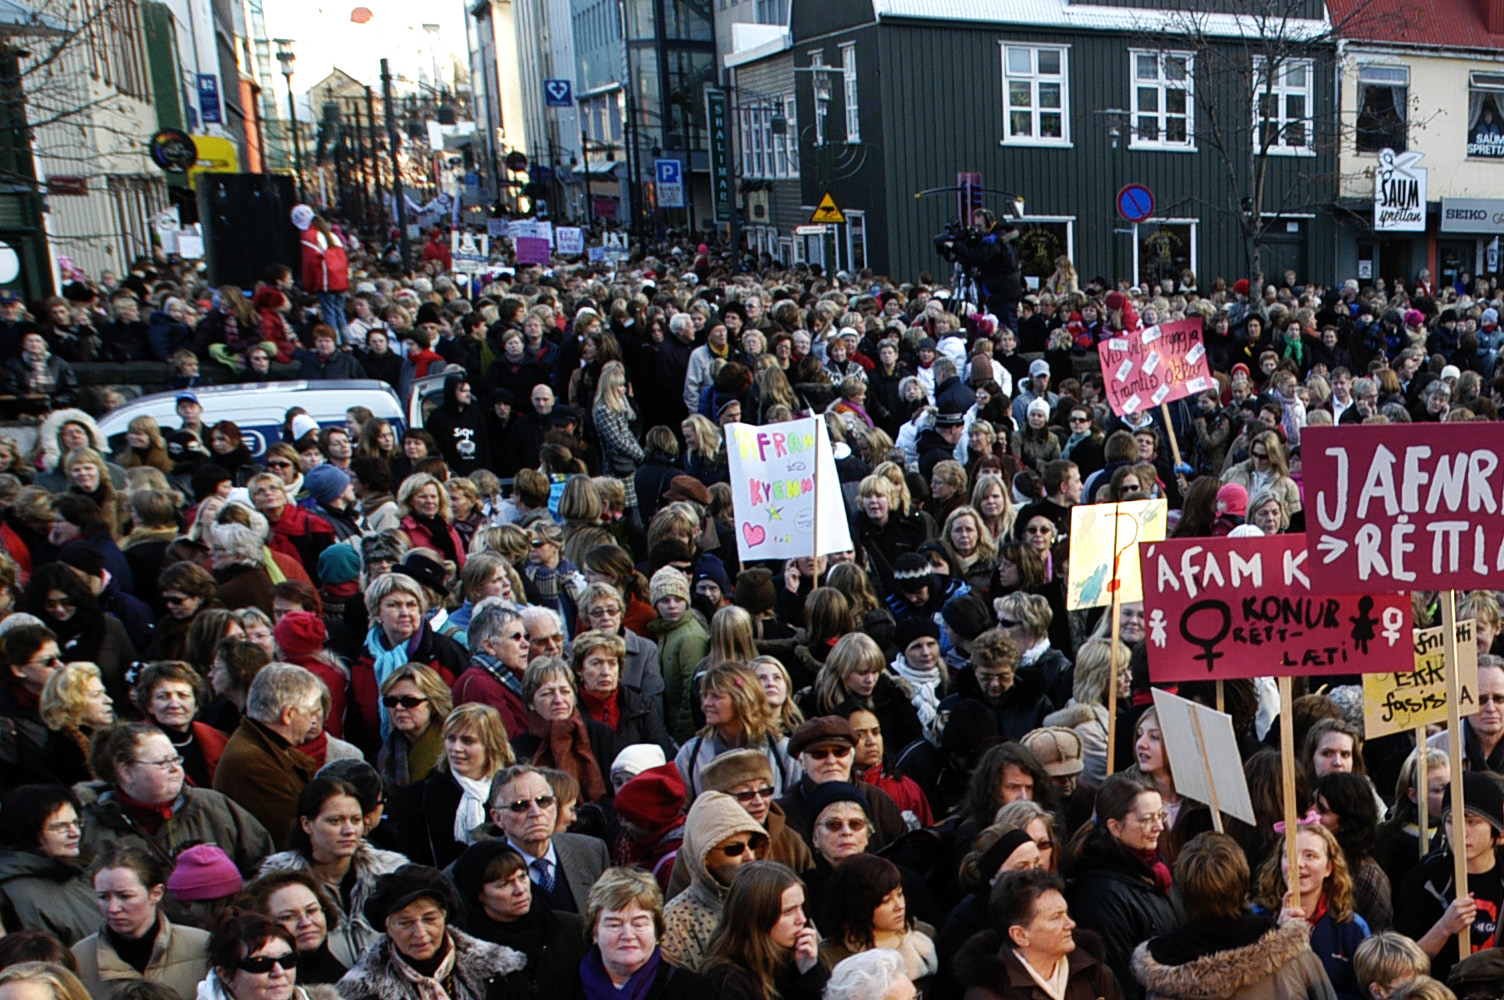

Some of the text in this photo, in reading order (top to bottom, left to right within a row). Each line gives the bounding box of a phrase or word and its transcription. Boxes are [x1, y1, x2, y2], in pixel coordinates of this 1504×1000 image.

[714, 105, 728, 201] SHALIMAR
[662, 164, 673, 180] P
[1381, 178, 1419, 207] SAUM
[1379, 207, 1422, 227] sprettan
[1446, 208, 1488, 221] SEIKO
[1241, 596, 1340, 629] KONUR
